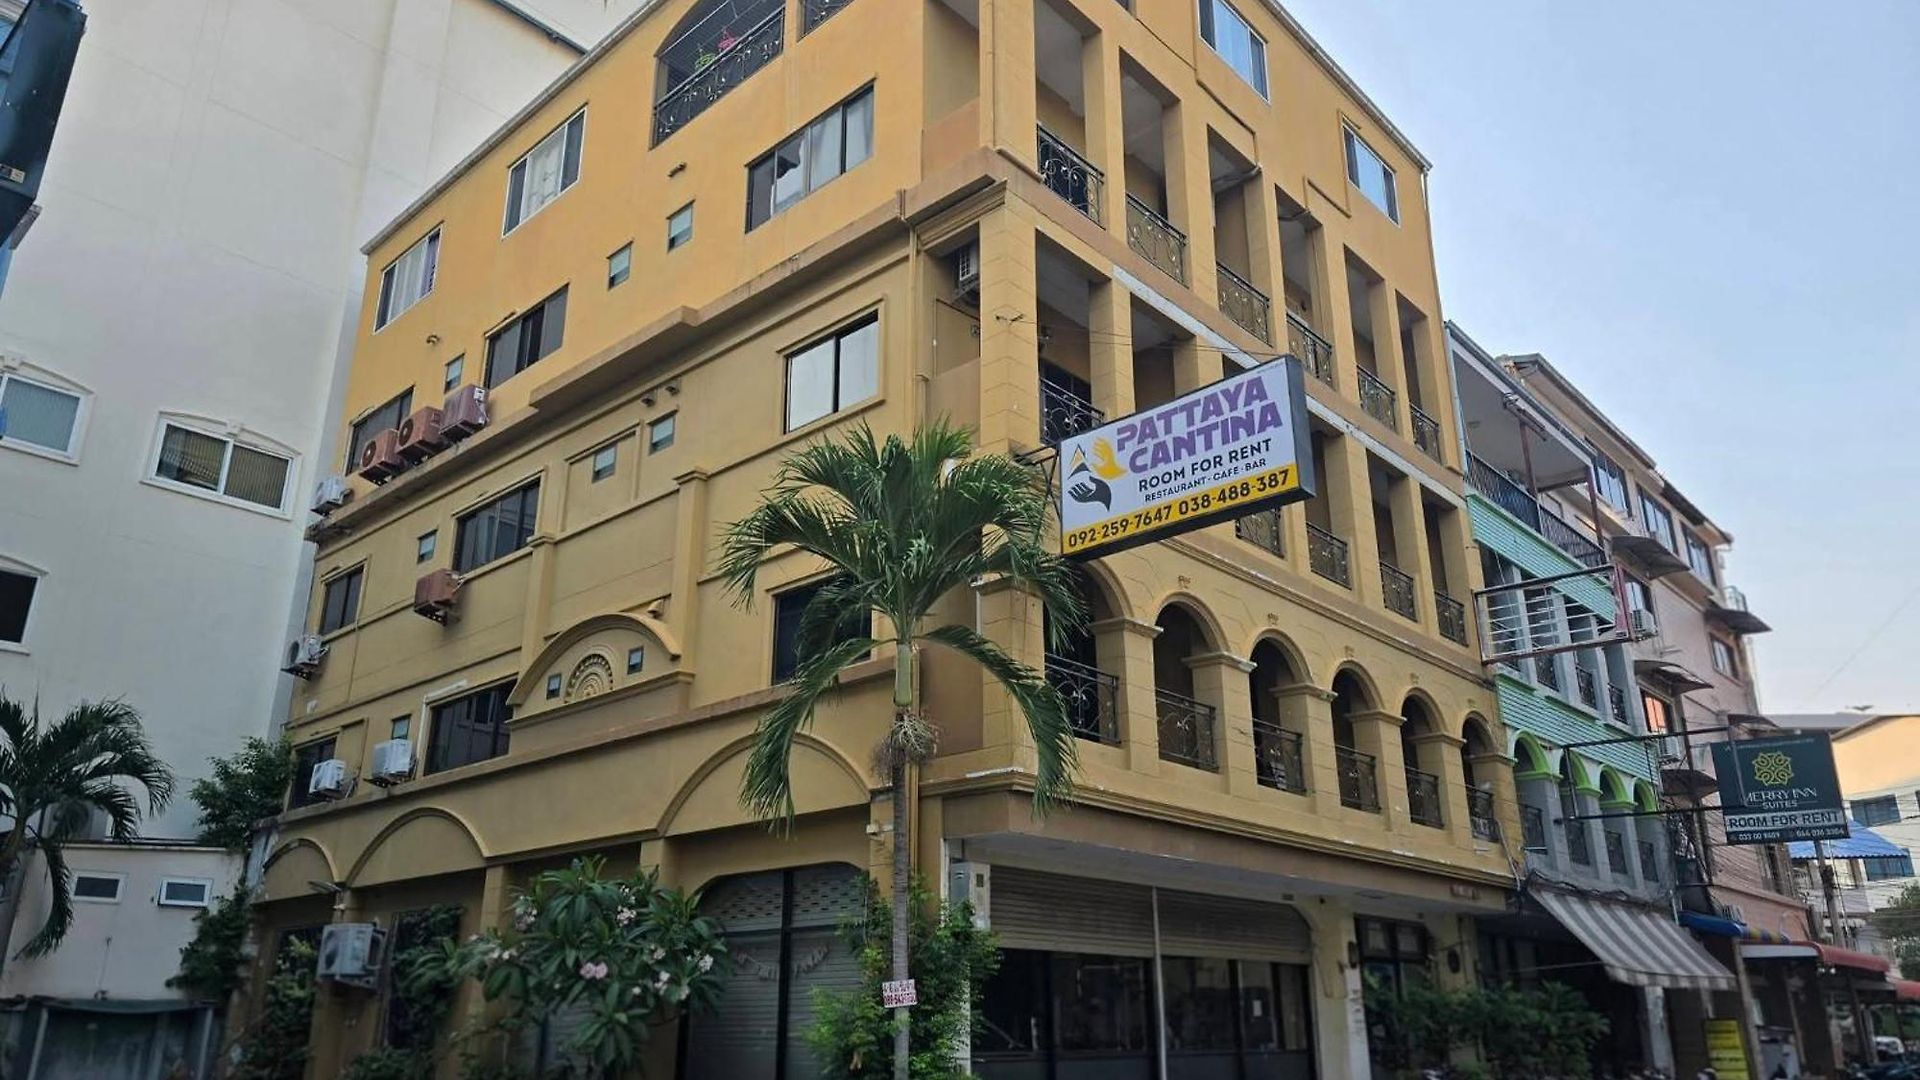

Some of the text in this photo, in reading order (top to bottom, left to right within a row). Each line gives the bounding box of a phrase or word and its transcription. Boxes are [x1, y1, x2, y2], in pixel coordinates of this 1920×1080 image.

[1117, 376, 1268, 452] PATTAYA
[1129, 402, 1283, 474] CANTINA
[1139, 438, 1272, 492] ROOM FOR RENT
[1069, 469, 1291, 547] 092-259-7647 038-488-387
[1729, 811, 1840, 829] ROOM FOR RENT
[1762, 800, 1798, 810] SUITES
